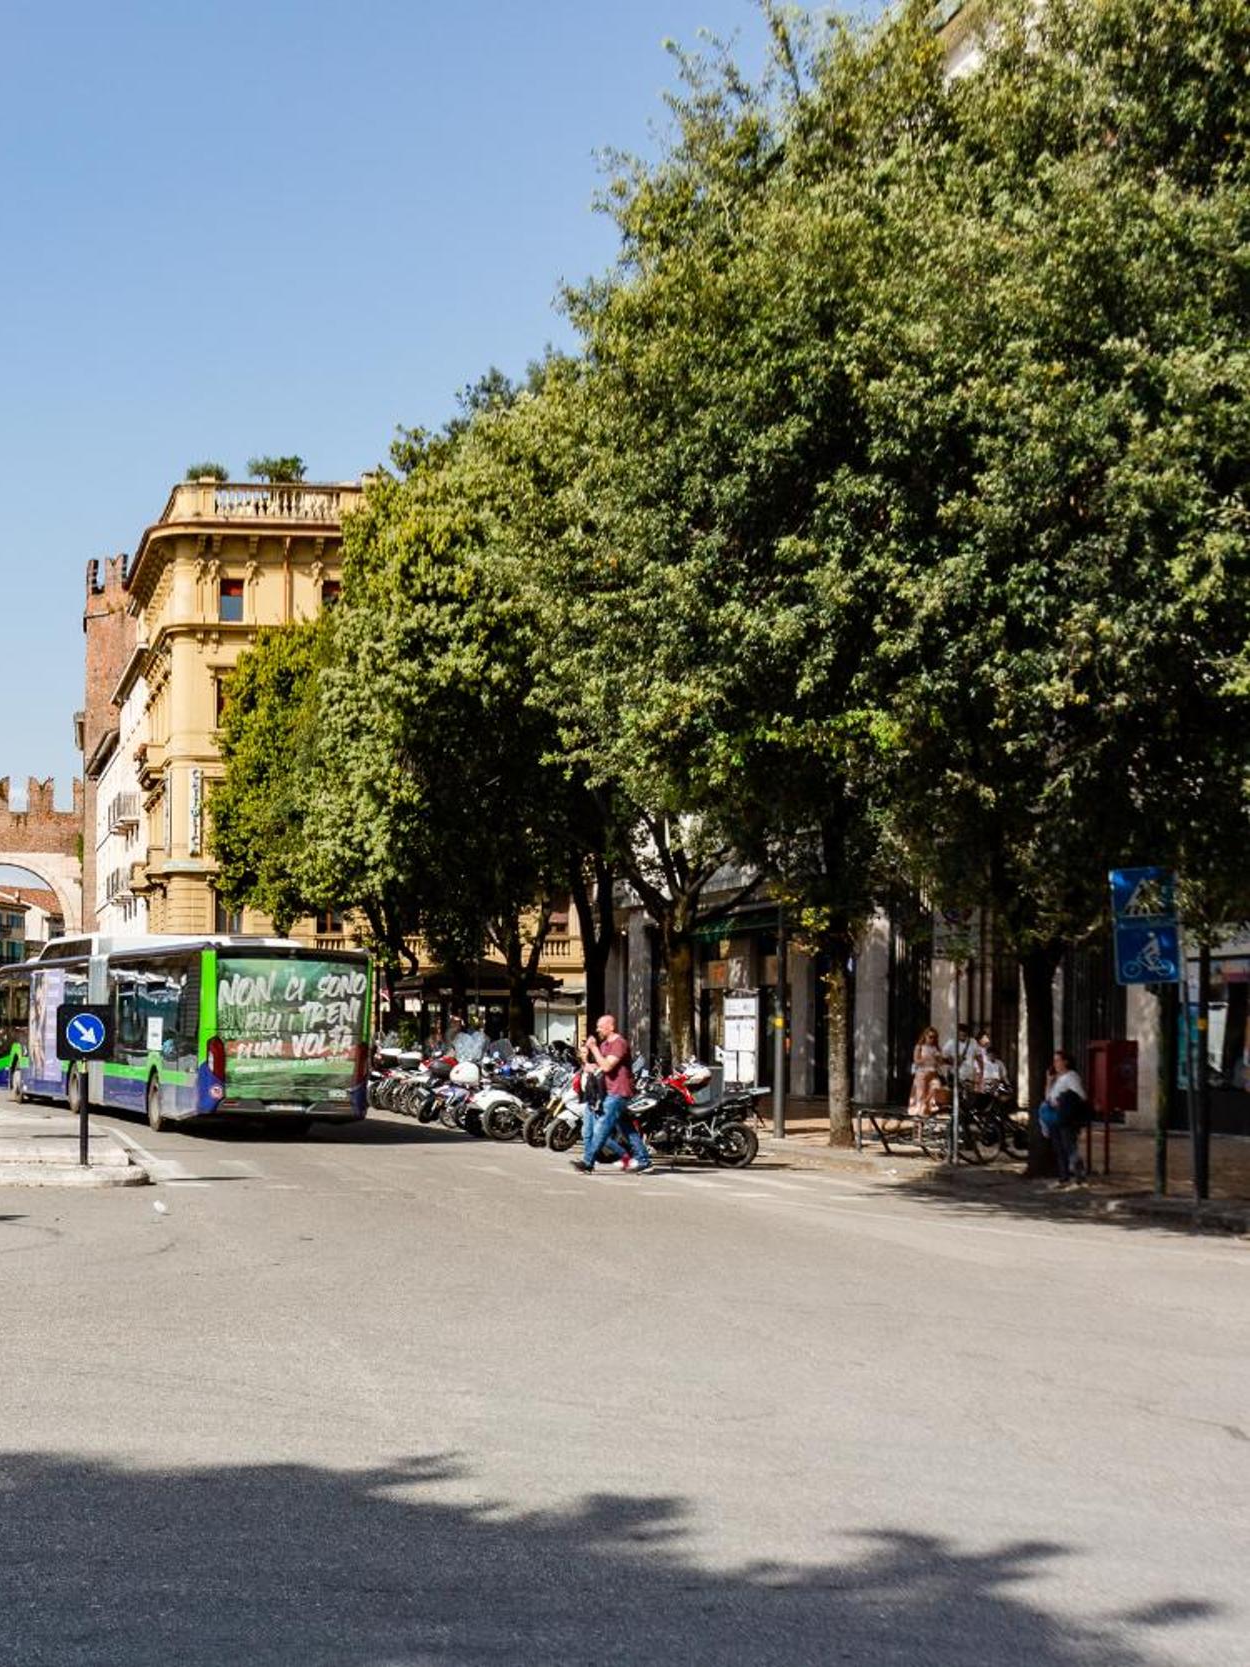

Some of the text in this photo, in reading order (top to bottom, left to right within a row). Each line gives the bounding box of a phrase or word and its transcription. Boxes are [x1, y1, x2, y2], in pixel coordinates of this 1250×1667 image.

[218, 971, 367, 1009] NON CI SONO
[298, 997, 361, 1031] TRENI
[292, 1025, 353, 1057] VOLTA
